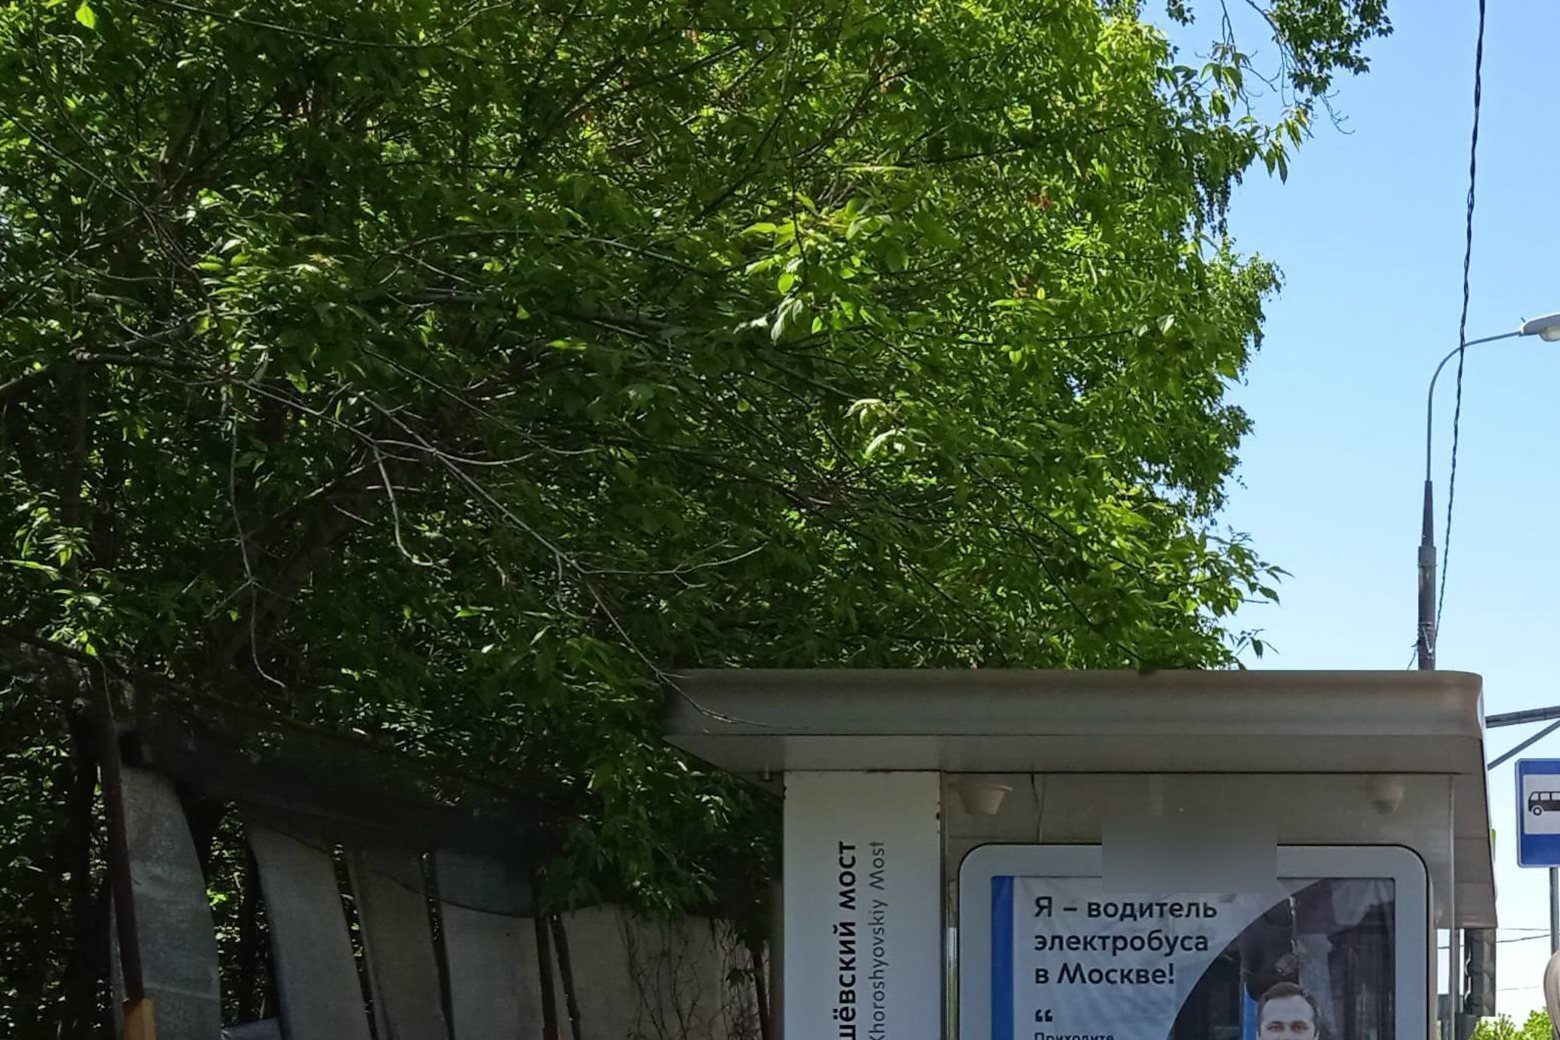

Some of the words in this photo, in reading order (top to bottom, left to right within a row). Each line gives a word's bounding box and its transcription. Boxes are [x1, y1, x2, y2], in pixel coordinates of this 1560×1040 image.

[838, 841, 857, 910] мост
[869, 841, 885, 890] Most
[1034, 896, 1053, 918] Я
[1087, 900, 1217, 922] водитель
[1034, 929, 1209, 957] электробуса
[1035, 968, 1049, 985] в
[1057, 962, 1175, 985] Москве!
